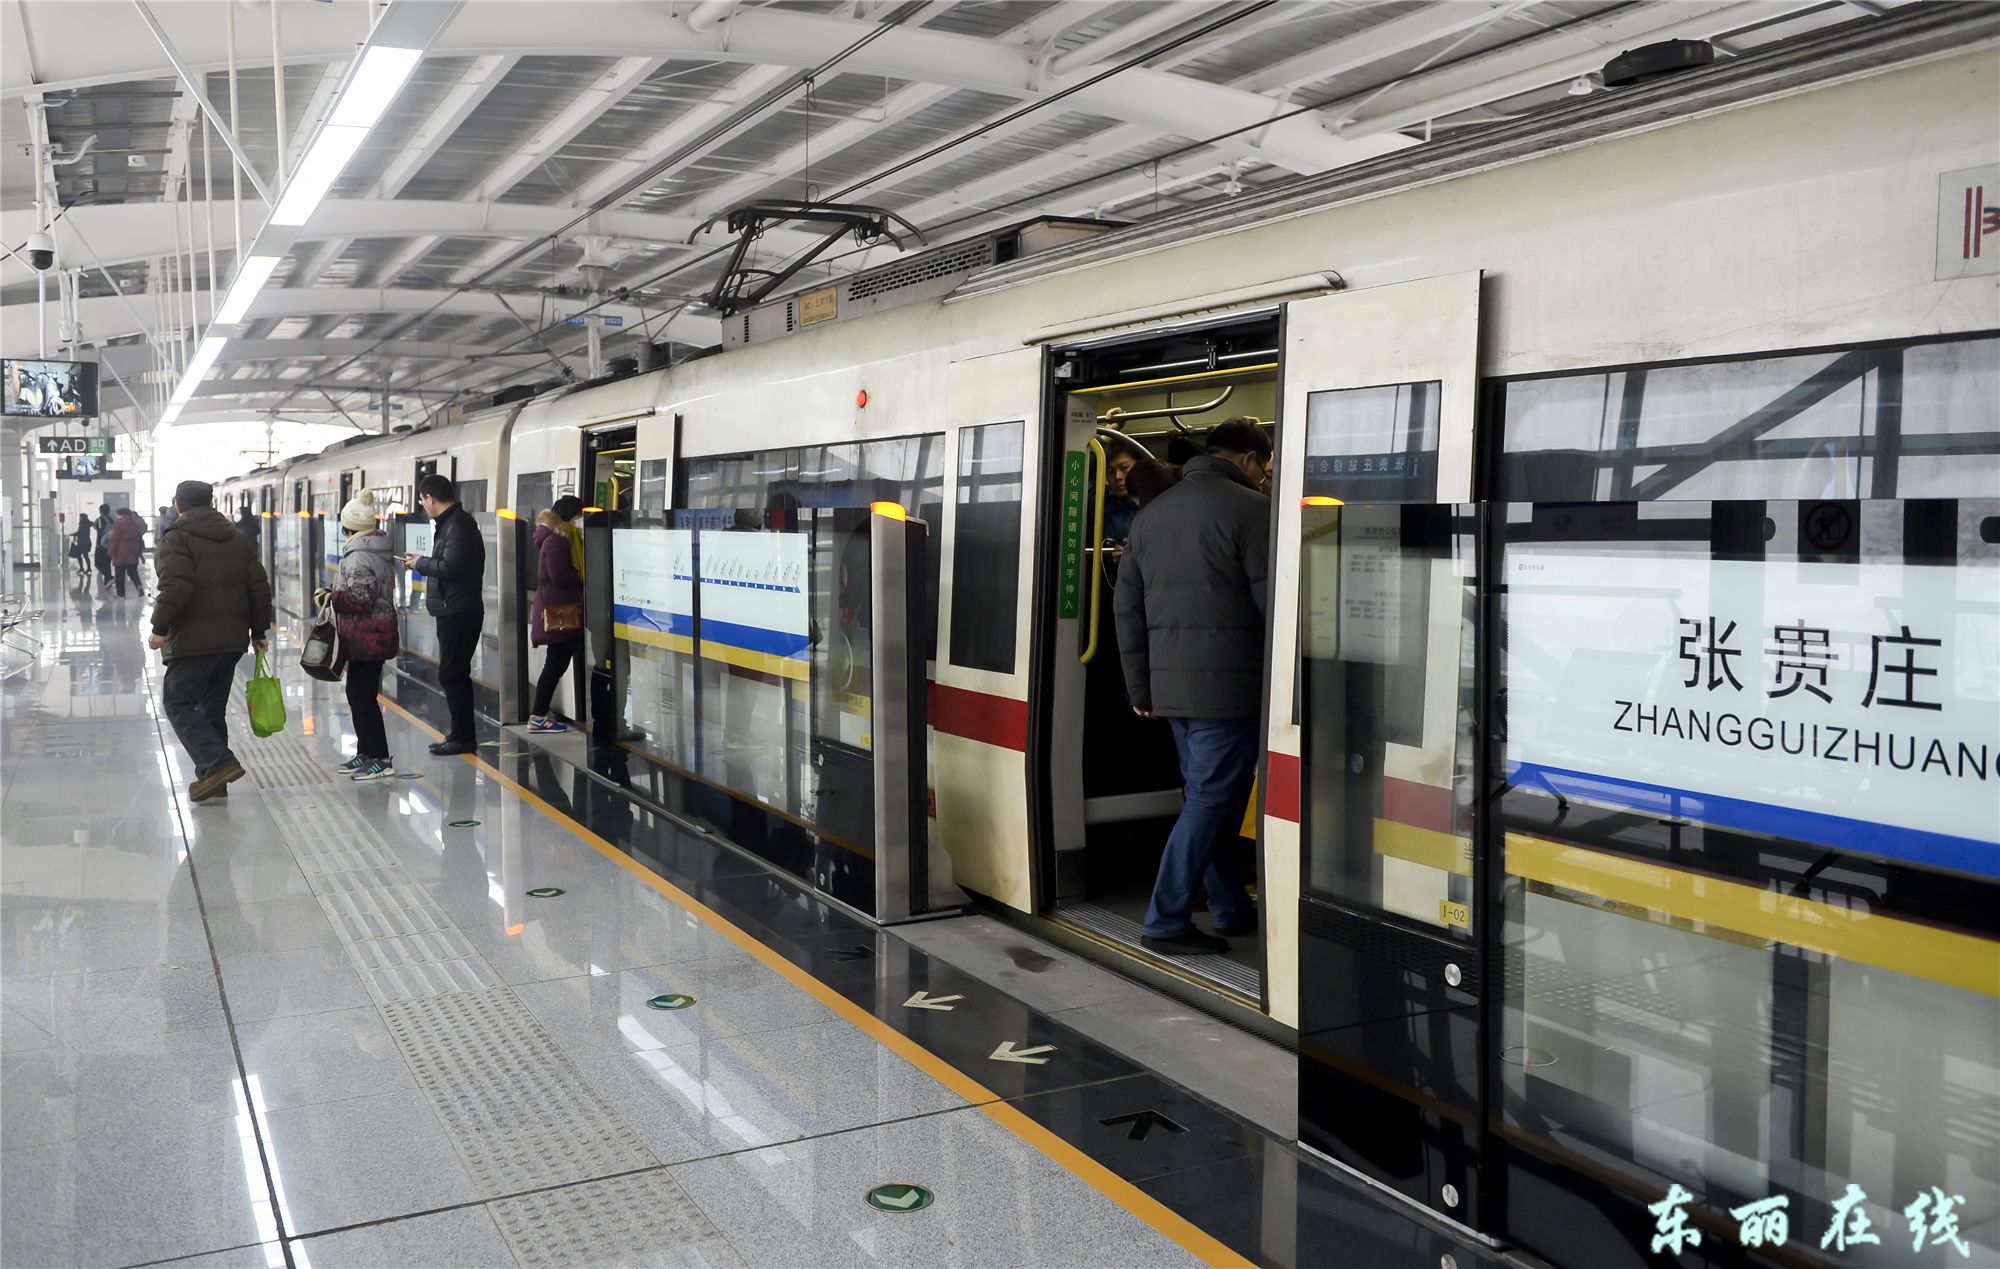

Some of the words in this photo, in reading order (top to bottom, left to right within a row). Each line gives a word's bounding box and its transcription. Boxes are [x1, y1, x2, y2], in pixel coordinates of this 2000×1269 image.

[60, 439, 87, 452] AD
[1679, 616, 1943, 711] 张贵庄
[1613, 701, 2000, 781] ZHANGGUIZHUAN
